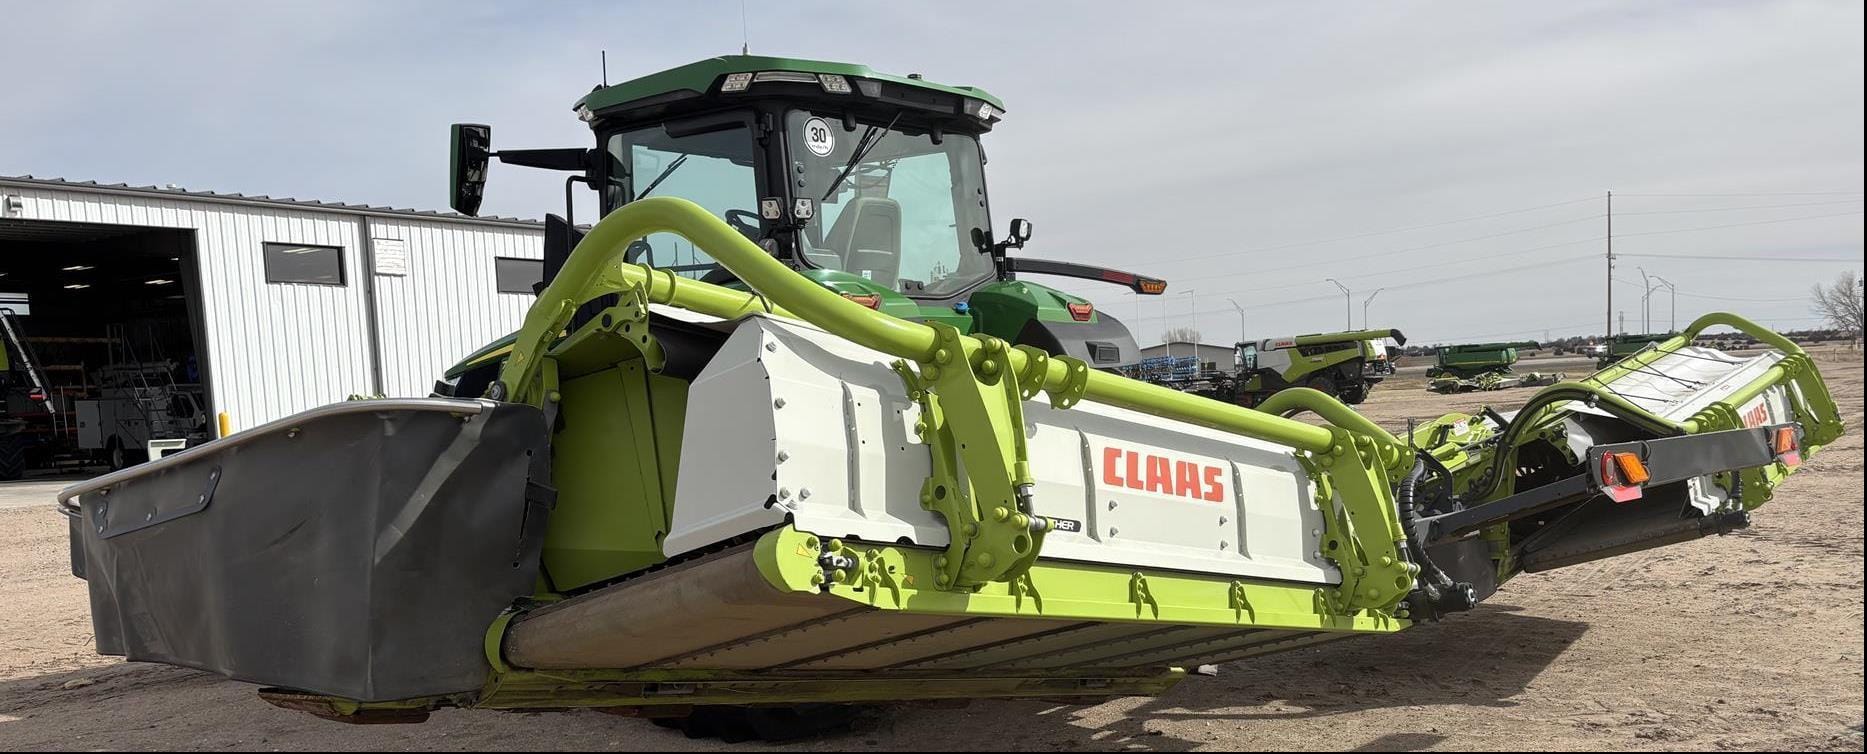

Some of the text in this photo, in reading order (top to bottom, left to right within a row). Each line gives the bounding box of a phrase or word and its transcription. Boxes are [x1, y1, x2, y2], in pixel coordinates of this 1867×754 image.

[811, 127, 826, 143] 30
[1103, 447, 1224, 502] CLAAS
[1054, 519, 1074, 531] HER
